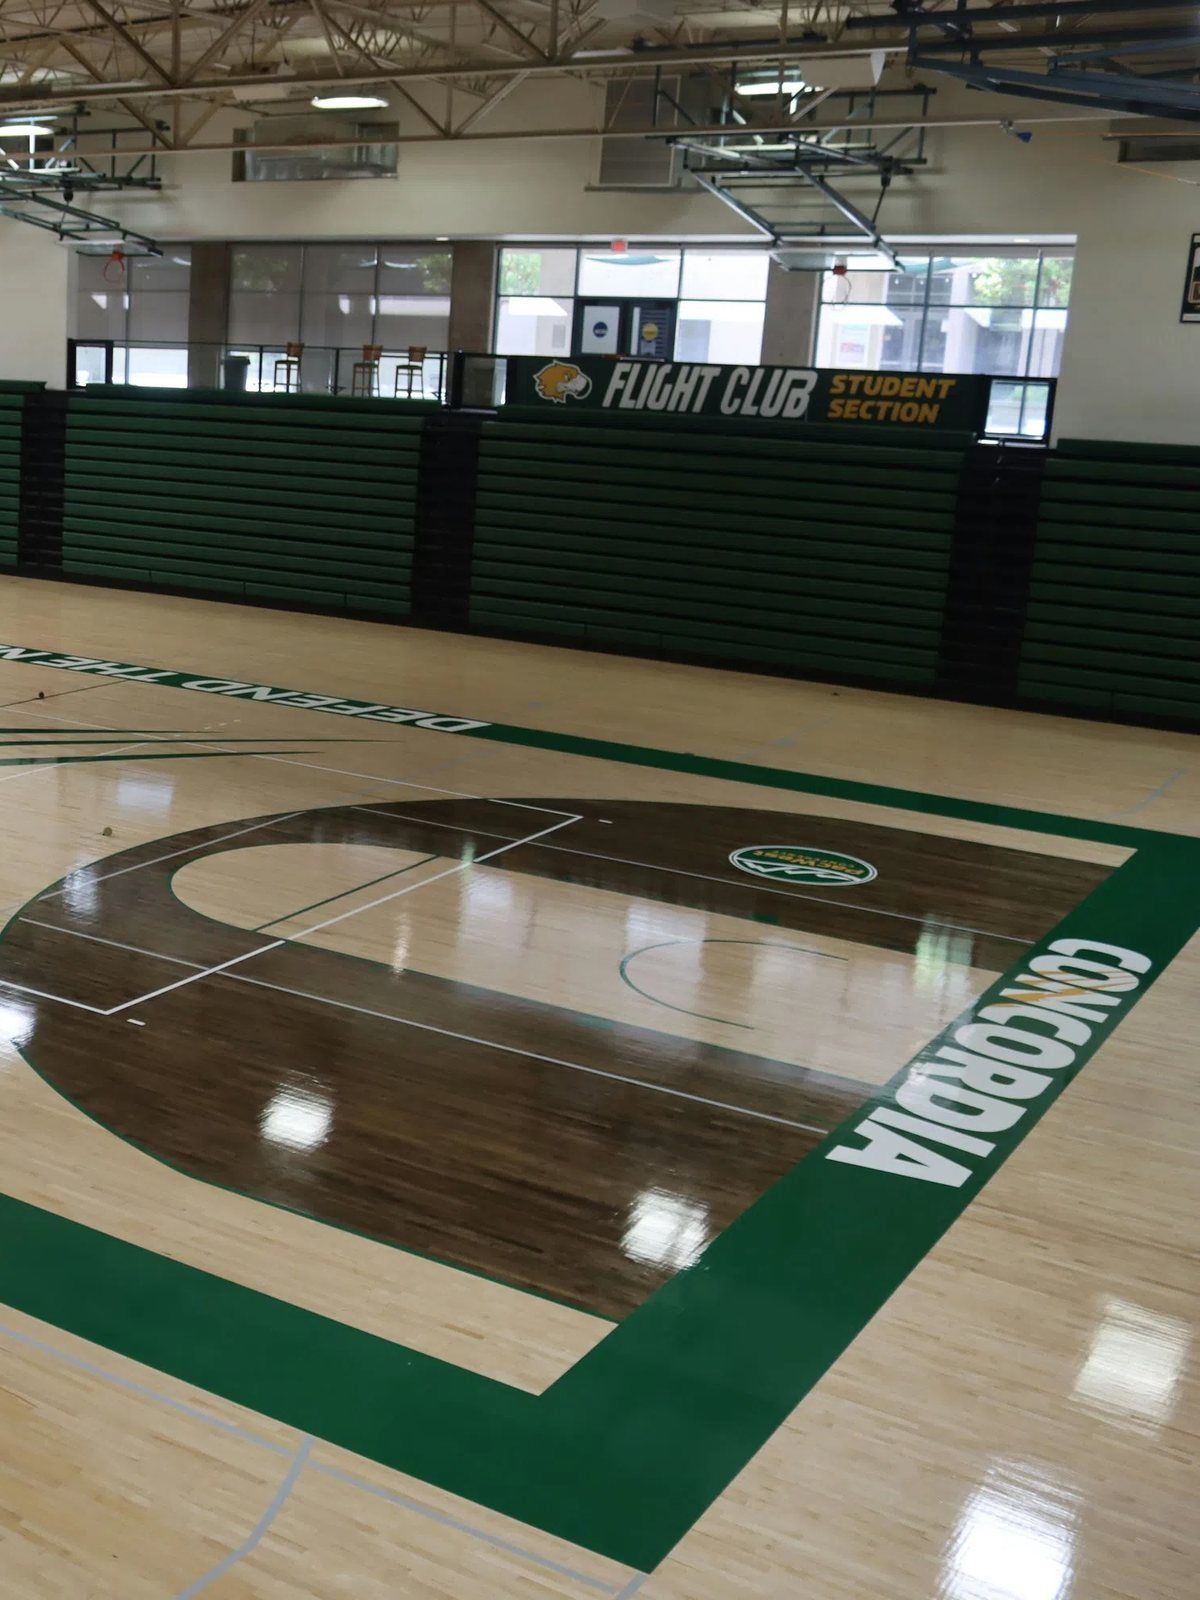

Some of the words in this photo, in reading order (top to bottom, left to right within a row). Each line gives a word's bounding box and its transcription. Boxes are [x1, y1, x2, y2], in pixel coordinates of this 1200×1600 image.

[602, 362, 722, 413] FLIGHT
[720, 367, 818, 418] CLUB
[829, 375, 955, 400] STUDENT
[827, 399, 940, 424] SECTION
[30, 656, 178, 682] THE
[181, 680, 493, 732] DEFEND
[825, 938, 1152, 1188] CONCORDIA
